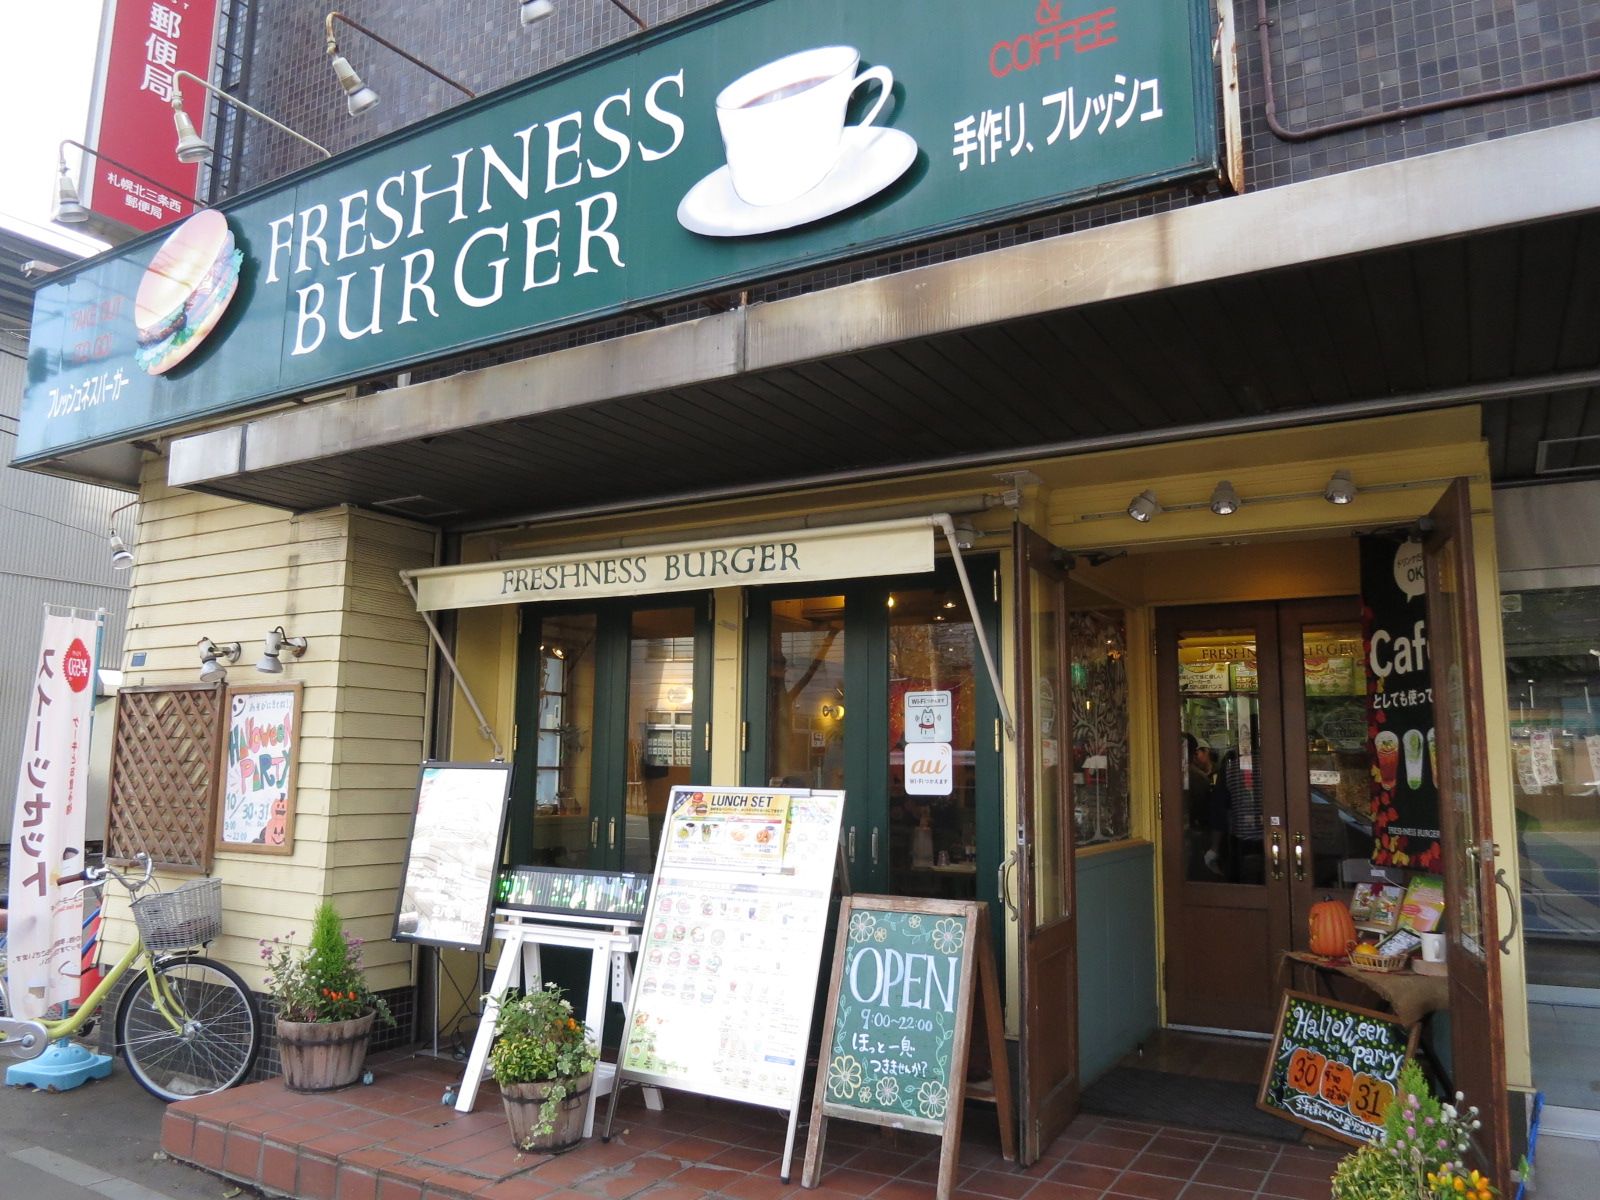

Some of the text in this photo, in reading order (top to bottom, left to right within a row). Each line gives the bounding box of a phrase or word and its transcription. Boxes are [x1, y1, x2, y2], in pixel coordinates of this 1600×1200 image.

[140, 1, 182, 103] 郵便局
[989, 7, 1118, 78] COFFEE
[107, 172, 182, 213] 札幌北三条西
[265, 68, 685, 284] FRESHNESS
[125, 193, 162, 220] 郵便局
[290, 191, 626, 356] BURGER
[48, 367, 129, 419] フレッシュネスバーガー
[501, 542, 800, 594] FRESHNESS BURGER
[1407, 566, 1424, 582] OK
[1369, 620, 1430, 677] Caf
[1373, 688, 1434, 709] としても使って
[911, 759, 947, 775] au
[711, 795, 774, 808] LUNCH SET
[850, 947, 958, 1013] OPEN
[852, 1033, 916, 1057] ほっと一息
[1293, 1006, 1389, 1046] Halloween
[1294, 1057, 1318, 1087] 30
[1352, 1045, 1405, 1080] party
[1355, 1083, 1381, 1117] 31
